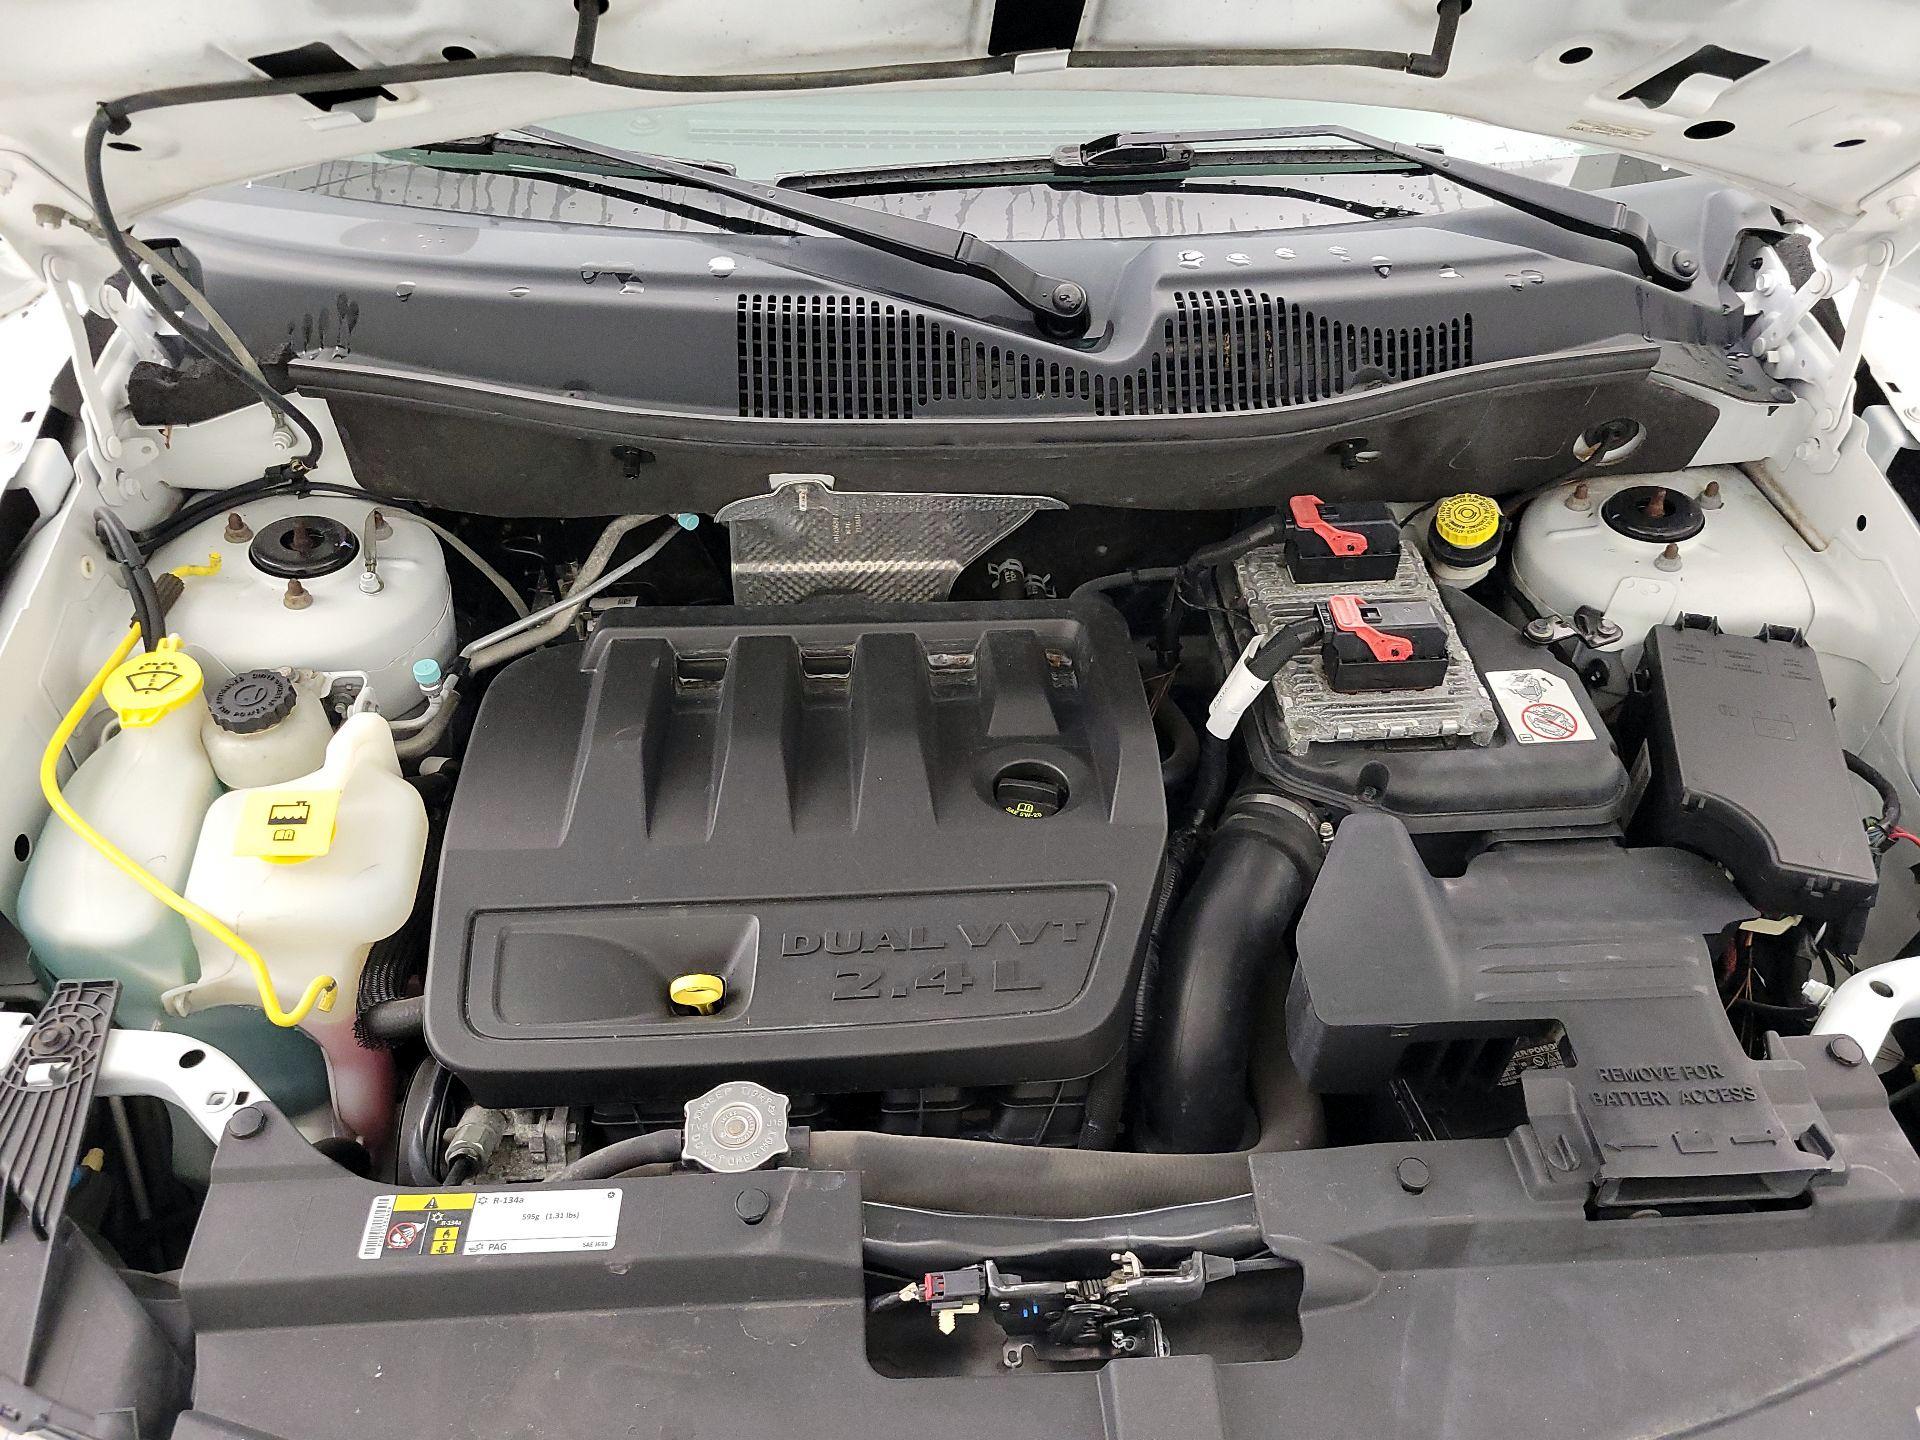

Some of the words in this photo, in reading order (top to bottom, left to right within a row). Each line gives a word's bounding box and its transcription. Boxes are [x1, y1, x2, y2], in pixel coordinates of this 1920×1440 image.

[780, 926, 947, 957] DUAL
[957, 919, 1087, 948] VVT
[1597, 1065, 1681, 1083] REMOVE
[1682, 1063, 1726, 1080] FOR
[1590, 1089, 1673, 1107] BATTERY
[1679, 1086, 1759, 1105] ACCESS
[492, 1196, 525, 1205] R-134a
[521, 1212, 540, 1221] 595g
[487, 1242, 508, 1252] PAG
